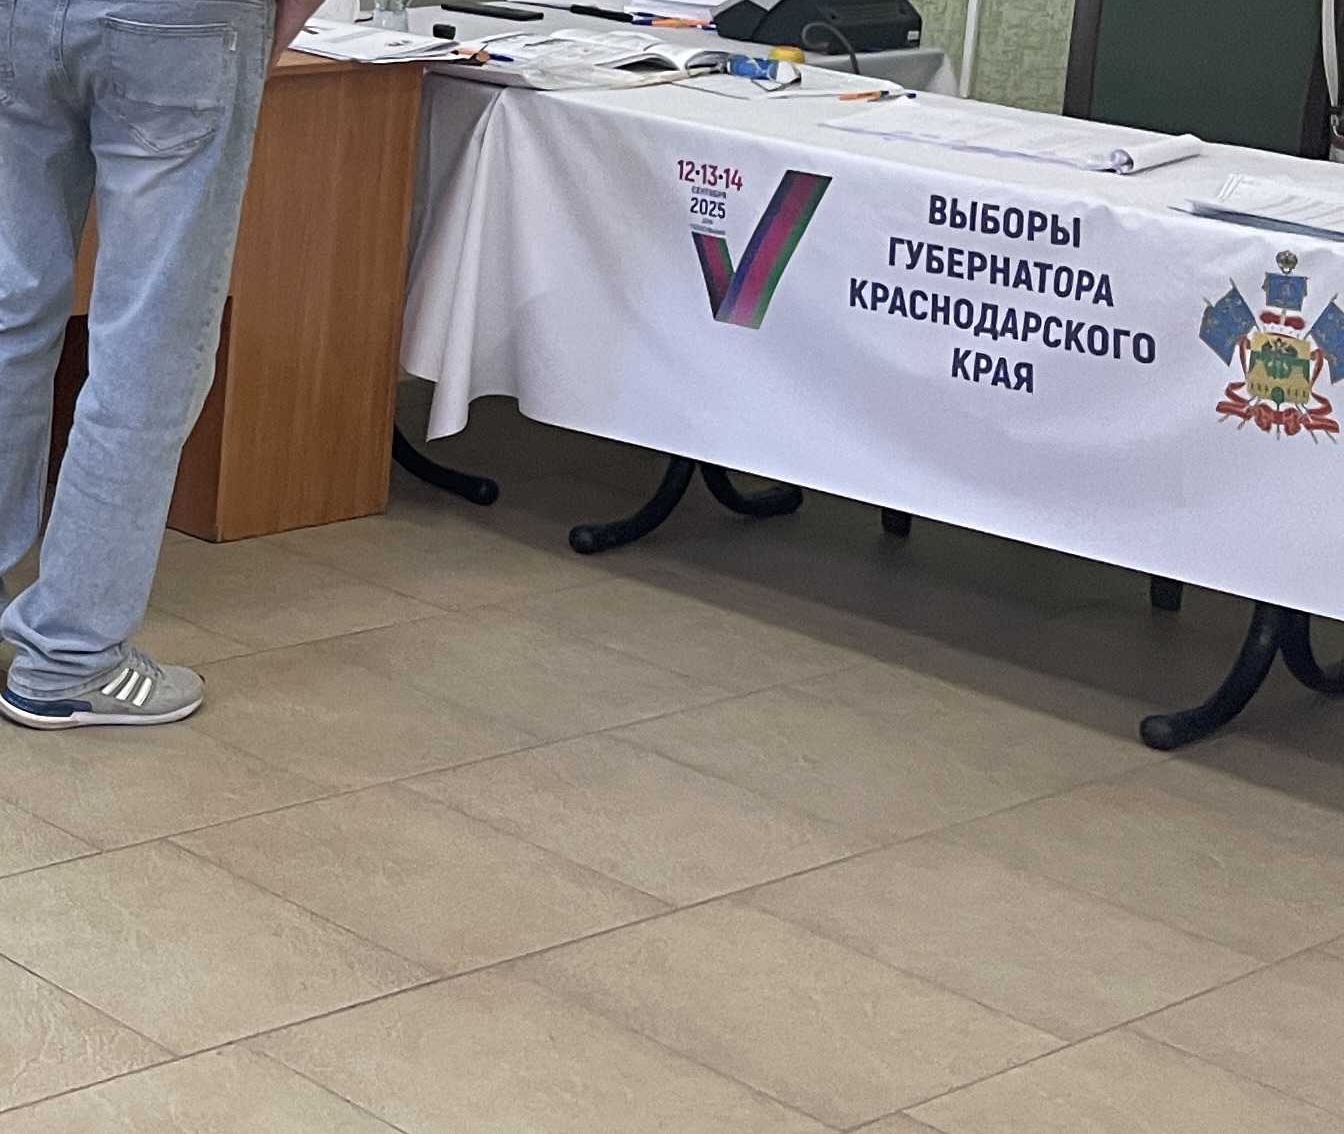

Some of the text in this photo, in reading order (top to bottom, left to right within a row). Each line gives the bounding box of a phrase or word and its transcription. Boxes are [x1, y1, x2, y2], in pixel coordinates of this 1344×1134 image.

[689, 197, 726, 219] 2025
[928, 194, 1081, 248] ВЫБОРЫ
[888, 236, 1114, 307] ГУБЕРНАТОРА
[849, 277, 1156, 364] КРАСНОДАРСКОГО
[951, 347, 1034, 394] КРАЯ
